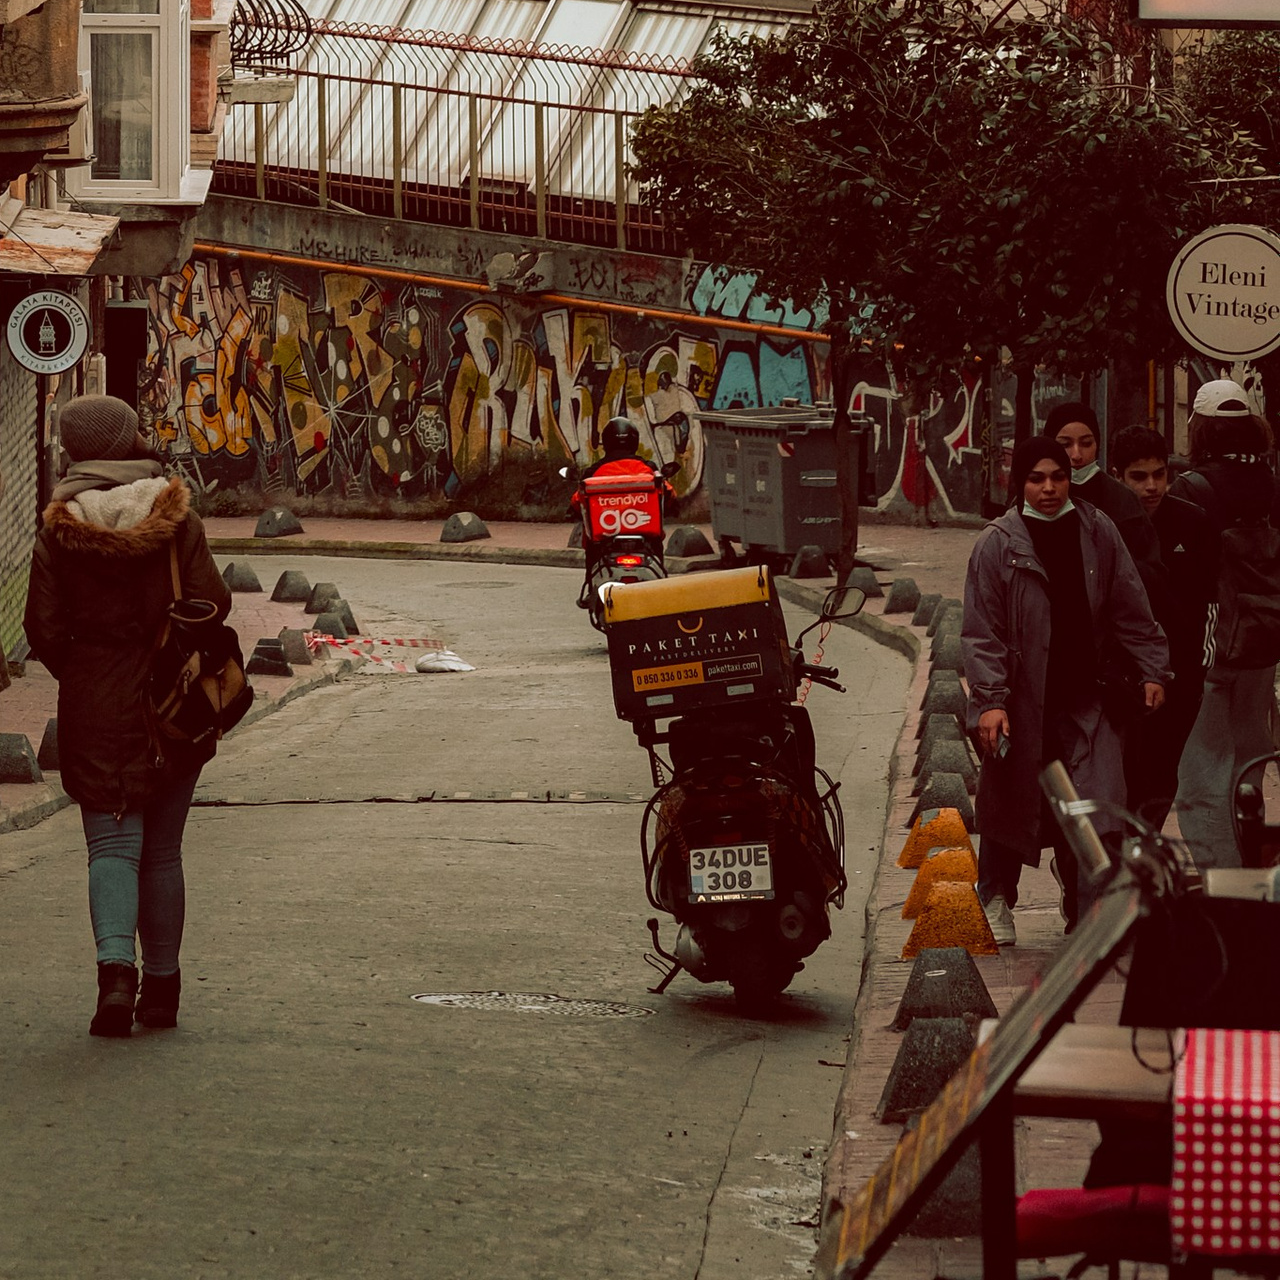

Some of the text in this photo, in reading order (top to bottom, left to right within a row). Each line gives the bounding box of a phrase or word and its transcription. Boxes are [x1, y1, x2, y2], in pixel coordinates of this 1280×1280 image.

[1198, 262, 1268, 288] Eleni
[10, 297, 38, 329] GALATA
[1185, 292, 1280, 326] Vintage
[598, 492, 648, 506] trendyol
[599, 508, 652, 537] go
[628, 628, 758, 655] PAKET TAXI
[644, 673, 658, 685] 850
[660, 671, 675, 683] 336
[677, 670, 682, 680] 0
[683, 668, 698, 679] 336
[707, 661, 758, 677] pakettaxi.com
[692, 846, 768, 871] 34DUE
[707, 870, 752, 891] 308
